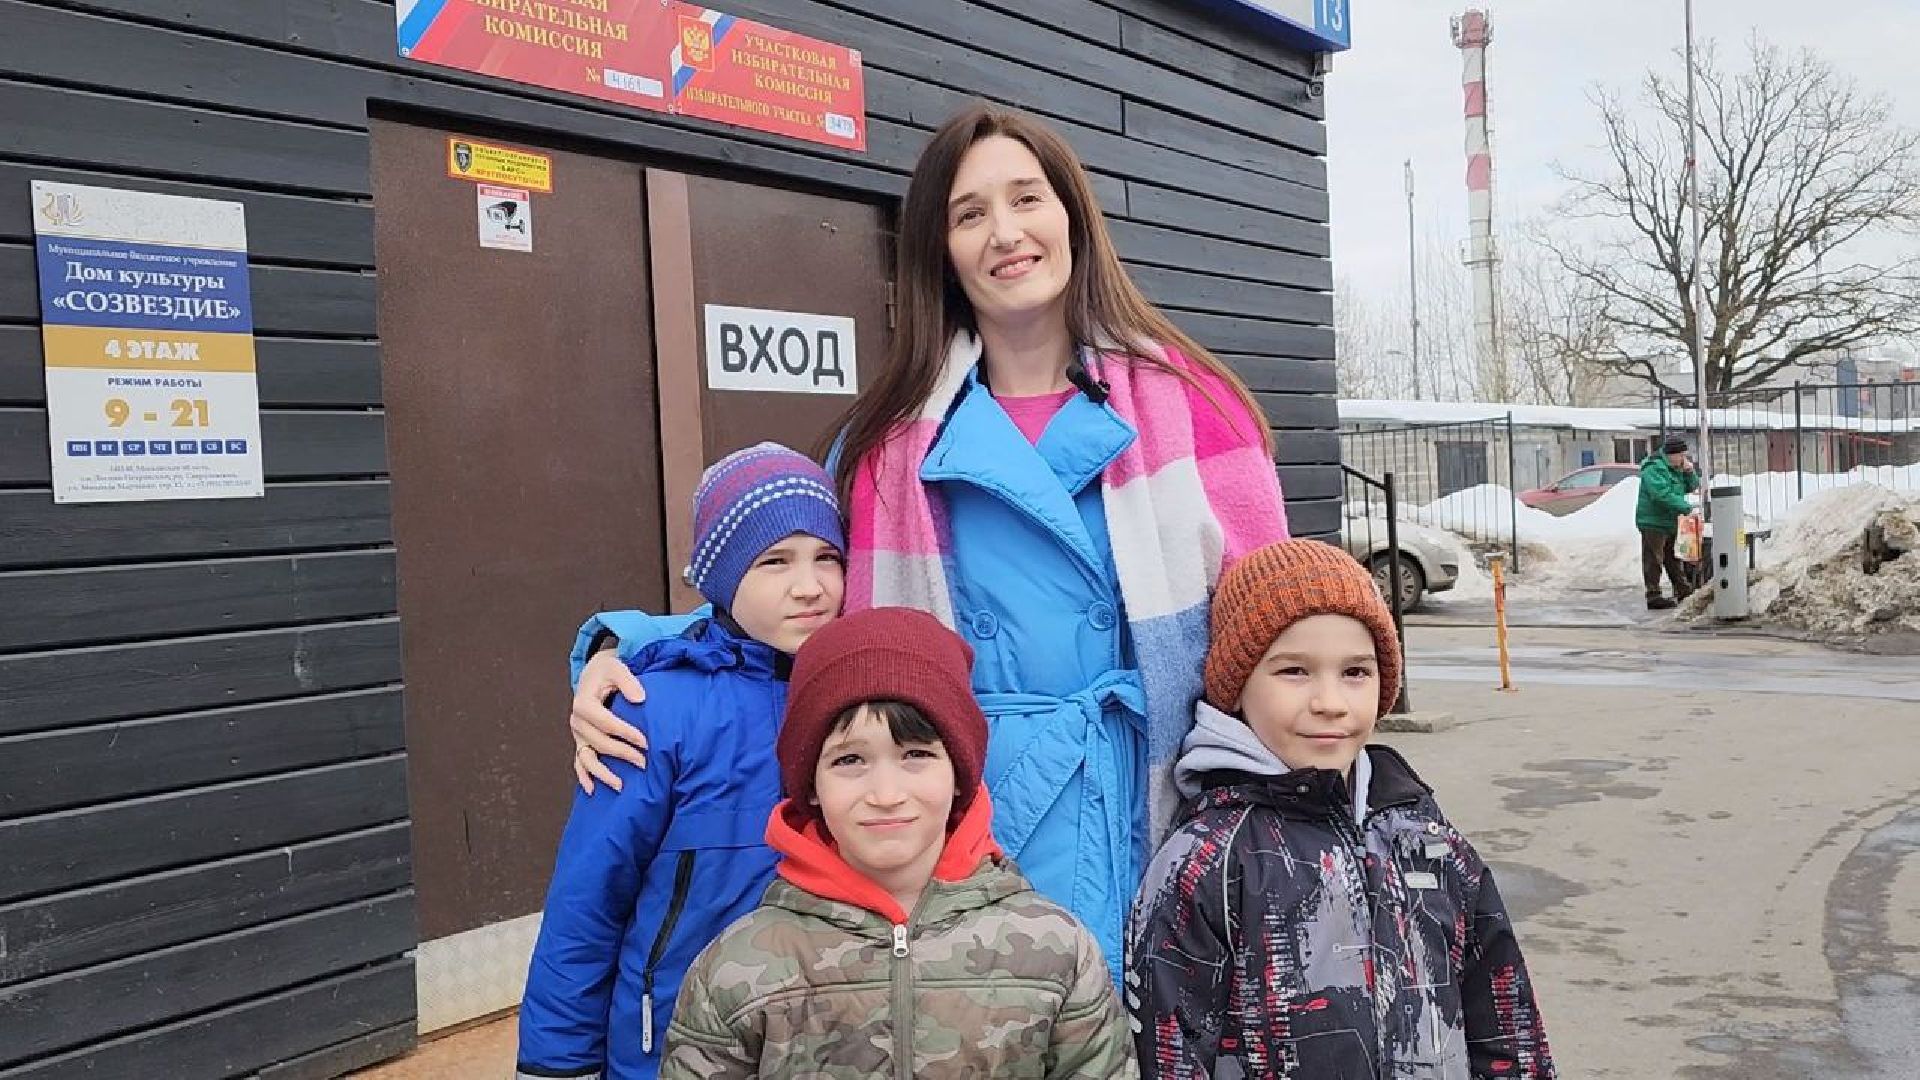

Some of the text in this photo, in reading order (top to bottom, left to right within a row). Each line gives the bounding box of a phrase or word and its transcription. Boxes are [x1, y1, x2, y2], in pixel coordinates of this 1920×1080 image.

[467, 0, 629, 41] ИРАТЕЛЬНАЯ
[485, 14, 603, 59] КОМИССИЯ
[744, 33, 836, 70] УЧАСТКОВАЯ
[732, 49, 850, 91] ИЗБИРАТЕЛЬНАЯ
[686, 85, 770, 117] ИЗБИРАТЕЛЬНОГО
[755, 74, 832, 104] КОМИССИЯ
[48, 243, 238, 269] Муниципальное бюджетное учреждение
[65, 261, 226, 292] Дом культуры
[53, 290, 241, 321] «СОЗВЕЗДИЕ»
[104, 339, 200, 361] 4 ЭТАЖ
[107, 377, 203, 388] РЕЖИМ РАБОТЫ
[104, 398, 130, 428] 9
[170, 399, 209, 427] 21
